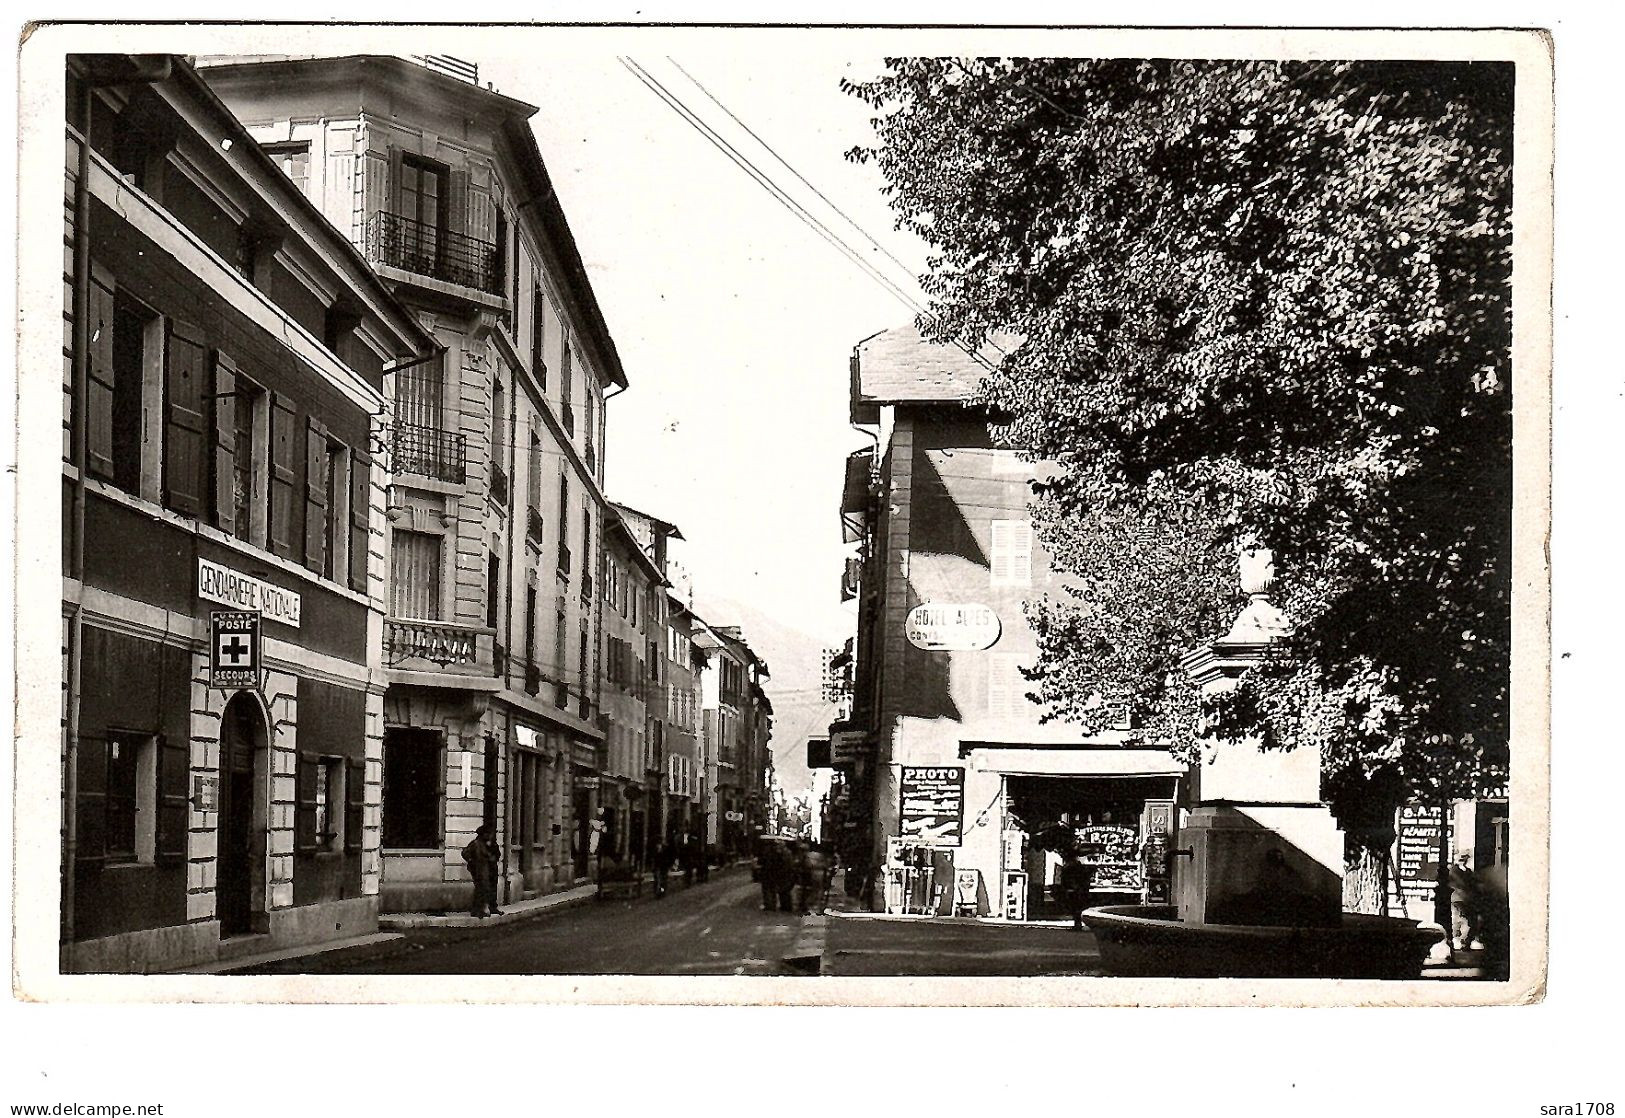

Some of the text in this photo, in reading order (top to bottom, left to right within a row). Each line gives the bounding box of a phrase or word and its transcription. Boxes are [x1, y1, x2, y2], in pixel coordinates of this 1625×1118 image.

[201, 564, 258, 609] GENDARMERIE
[218, 620, 252, 630] POSTE
[214, 670, 257, 681] SECOURS
[903, 768, 959, 780] PHOTO
